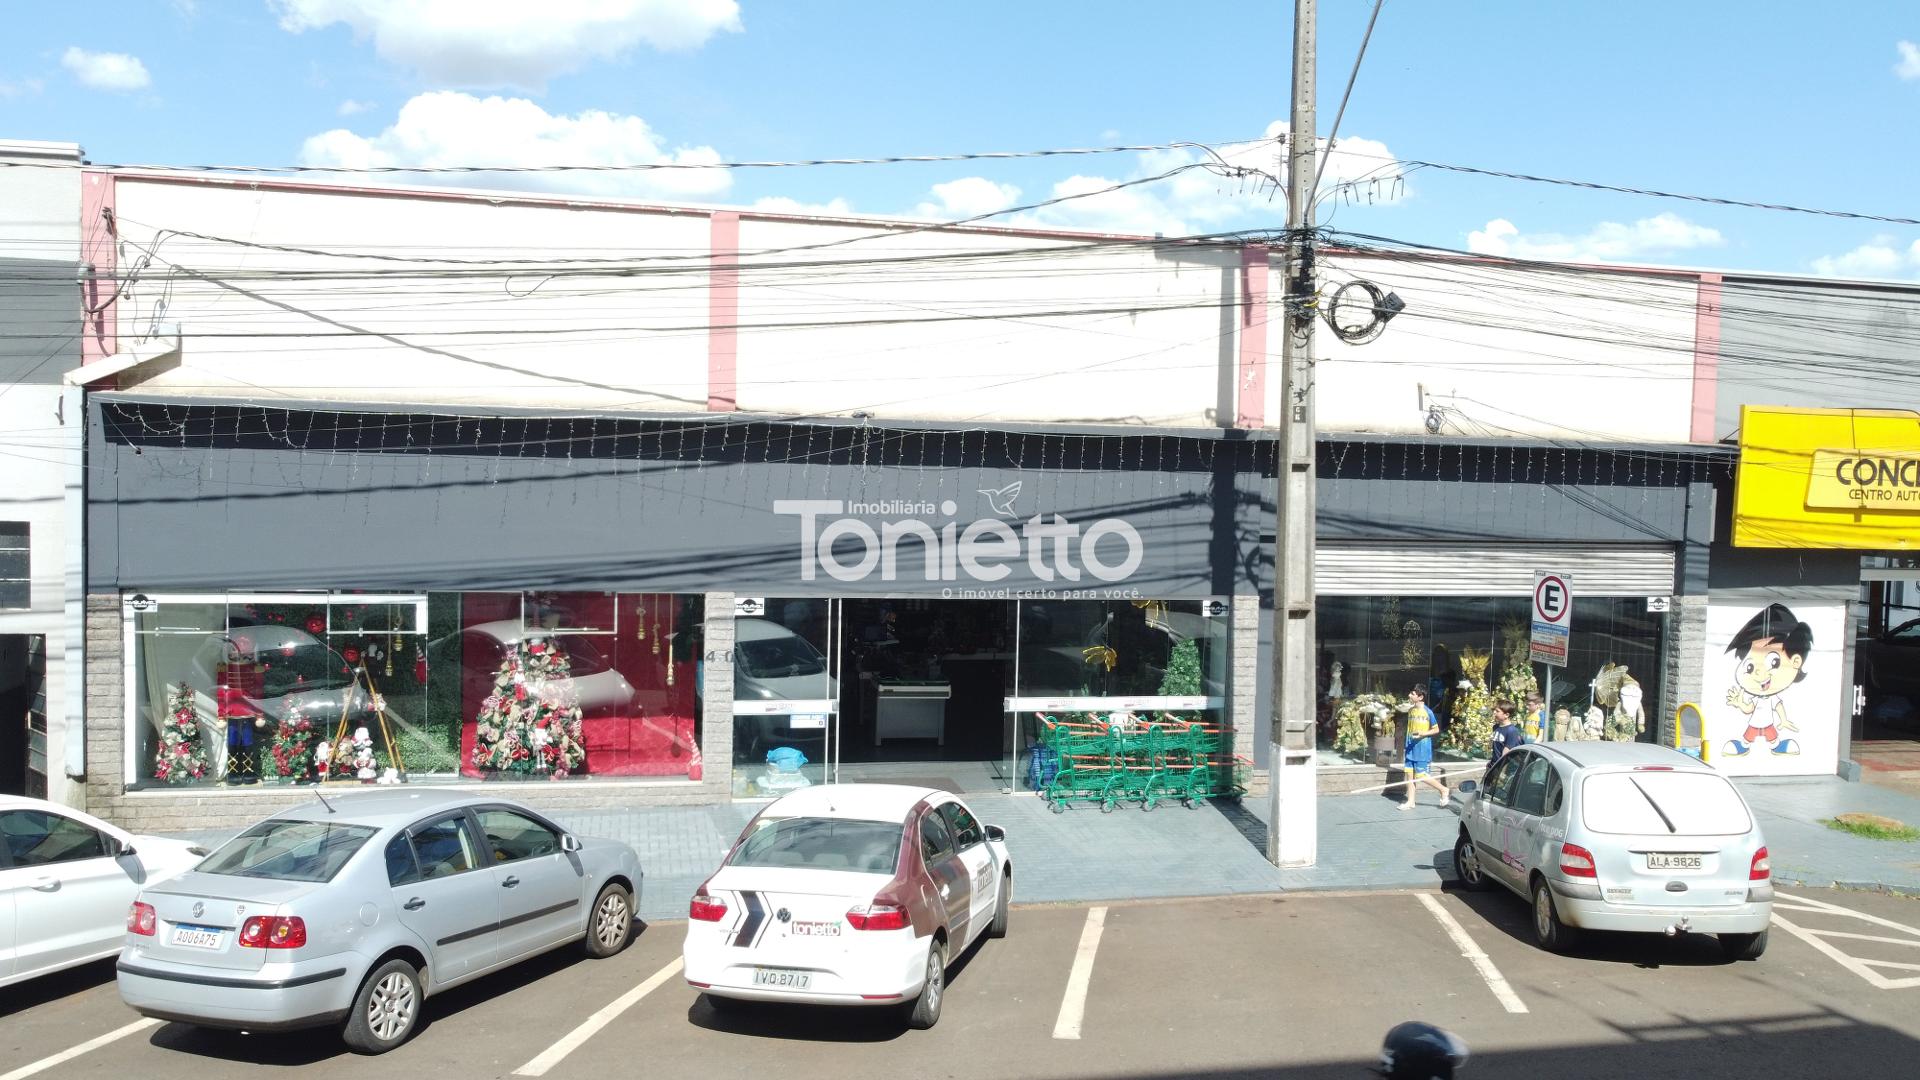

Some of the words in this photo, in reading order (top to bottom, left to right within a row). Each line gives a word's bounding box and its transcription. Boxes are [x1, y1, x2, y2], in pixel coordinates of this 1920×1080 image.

[1836, 458, 1920, 487] CONC
[1848, 489, 1892, 501] CENTRO
[1545, 585, 1560, 612] E
